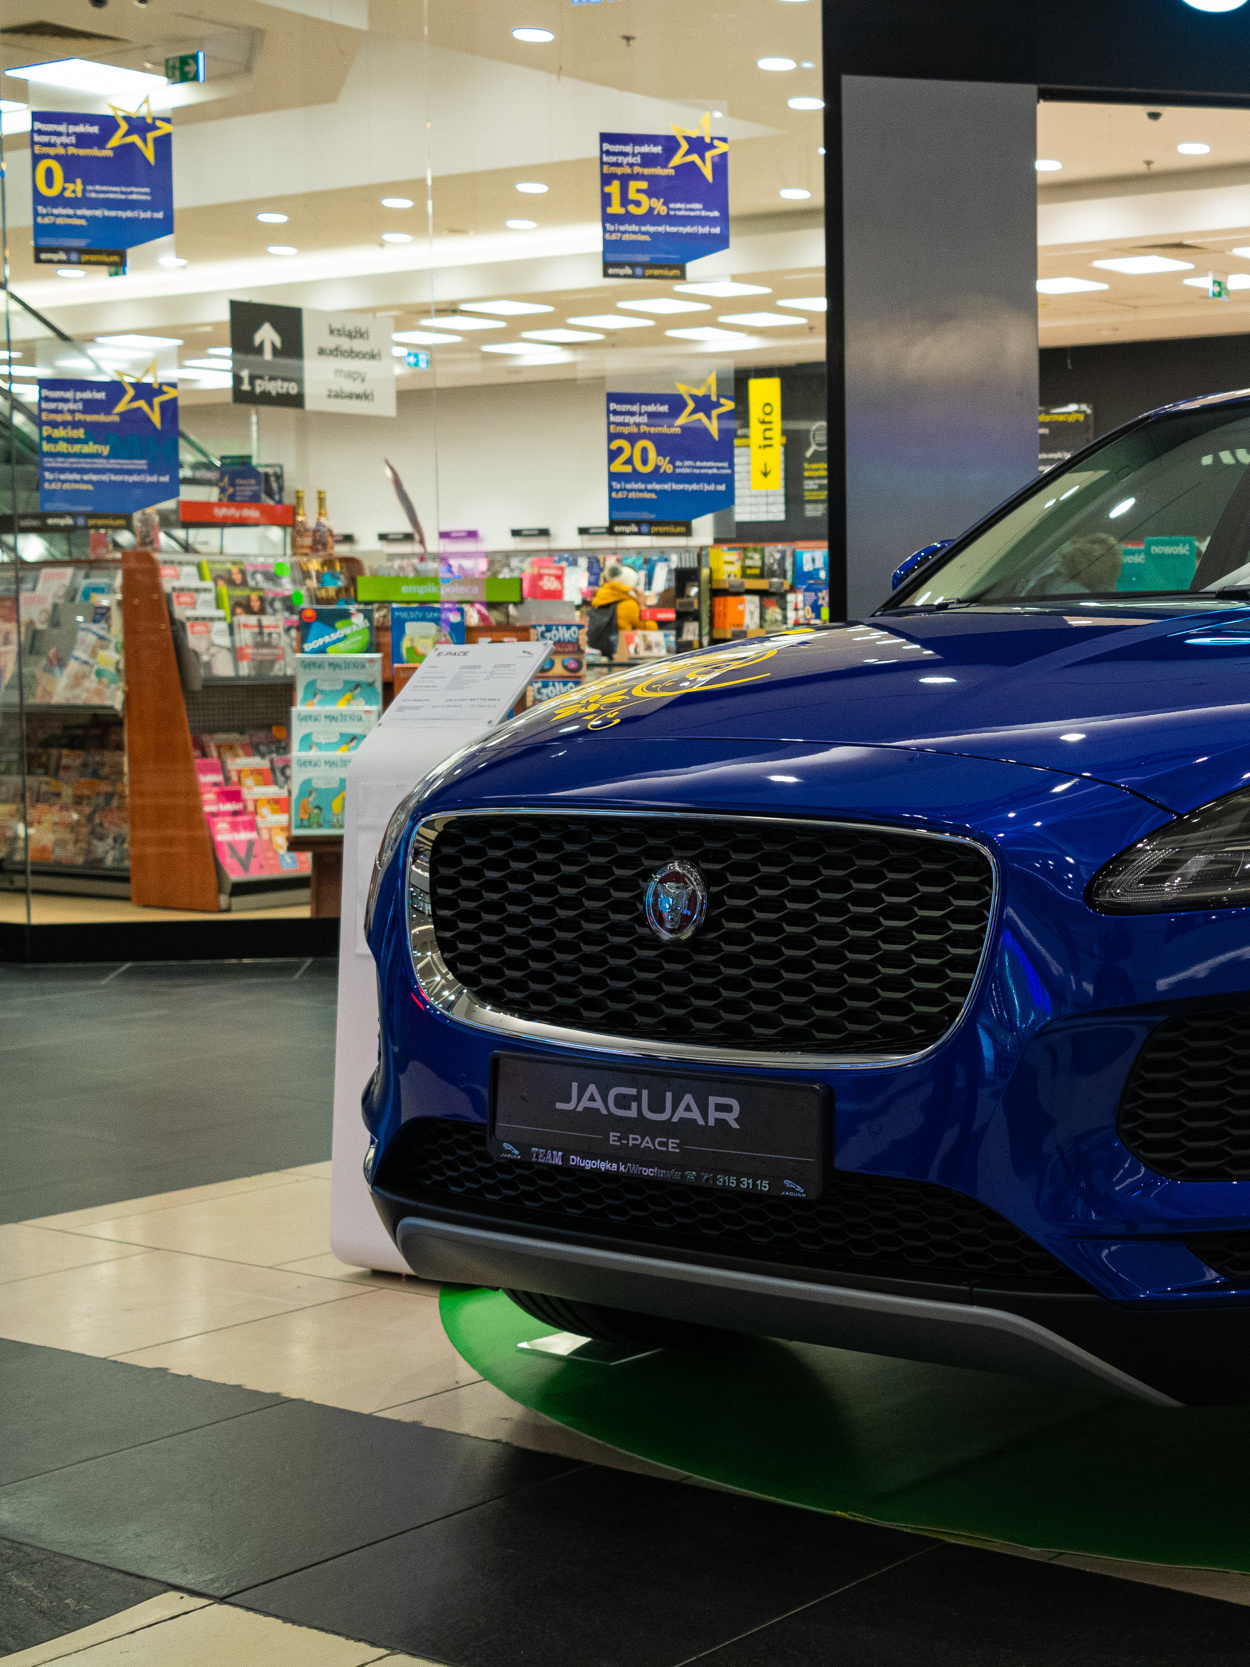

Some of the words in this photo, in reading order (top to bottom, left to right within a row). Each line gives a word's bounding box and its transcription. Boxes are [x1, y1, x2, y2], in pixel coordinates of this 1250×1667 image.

[602, 143, 633, 154] Poznaj
[634, 144, 663, 154] pakiet
[602, 154, 641, 164] korzyści
[602, 165, 632, 175] Empik
[633, 167, 675, 175] Premium
[608, 266, 633, 276] empik
[645, 268, 681, 276] premium
[328, 323, 370, 341] książki
[317, 344, 382, 361] audiobooki
[239, 368, 252, 391] 1
[254, 375, 299, 396] piętro
[334, 368, 367, 384] mapy
[327, 387, 375, 402] zabawki
[609, 402, 640, 413] Poznaj
[641, 403, 669, 413] pakiet
[609, 414, 648, 424] korzyści
[758, 402, 774, 450] info
[42, 425, 85, 439] Pakiet
[609, 425, 638, 434] Empik
[640, 425, 682, 434] Premium
[42, 441, 110, 456] kulturalny
[614, 524, 639, 533] empik
[651, 525, 686, 534] premium
[1150, 543, 1190, 555] nowość
[401, 581, 438, 595] empik
[440, 583, 479, 595] poleca
[555, 1081, 741, 1129] JAGUAR
[609, 1131, 680, 1152] E-PACE
[531, 1148, 563, 1165] TEAM
[569, 1155, 618, 1173] Długołęka
[716, 1174, 737, 1188] 315
[740, 1177, 753, 1190] 31
[755, 1179, 770, 1192] 15
[780, 1190, 807, 1198] JAGUAR
